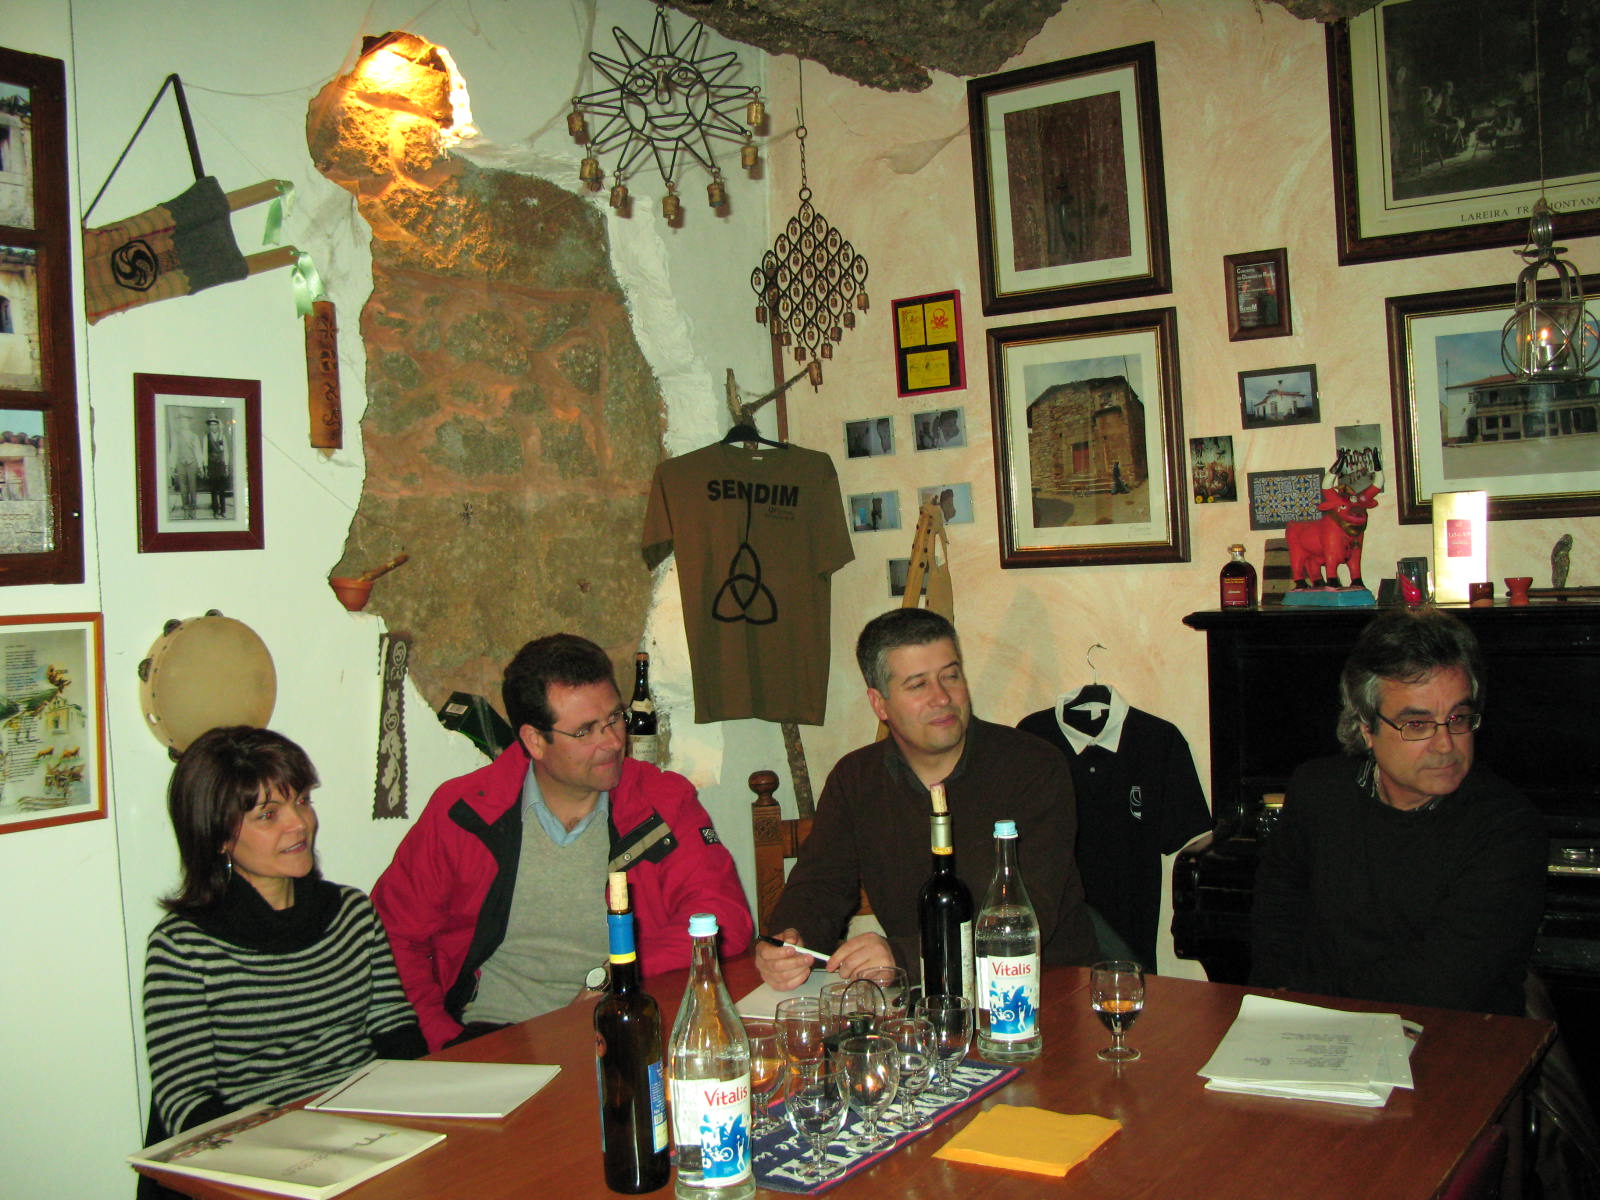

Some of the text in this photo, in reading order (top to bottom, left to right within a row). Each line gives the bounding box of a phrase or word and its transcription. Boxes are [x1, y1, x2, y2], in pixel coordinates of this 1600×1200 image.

[1460, 207, 1509, 223] LAREIRA
[707, 479, 800, 507] SENDIM
[992, 962, 1031, 976] Vitalis
[703, 1085, 748, 1107] Vitalis
